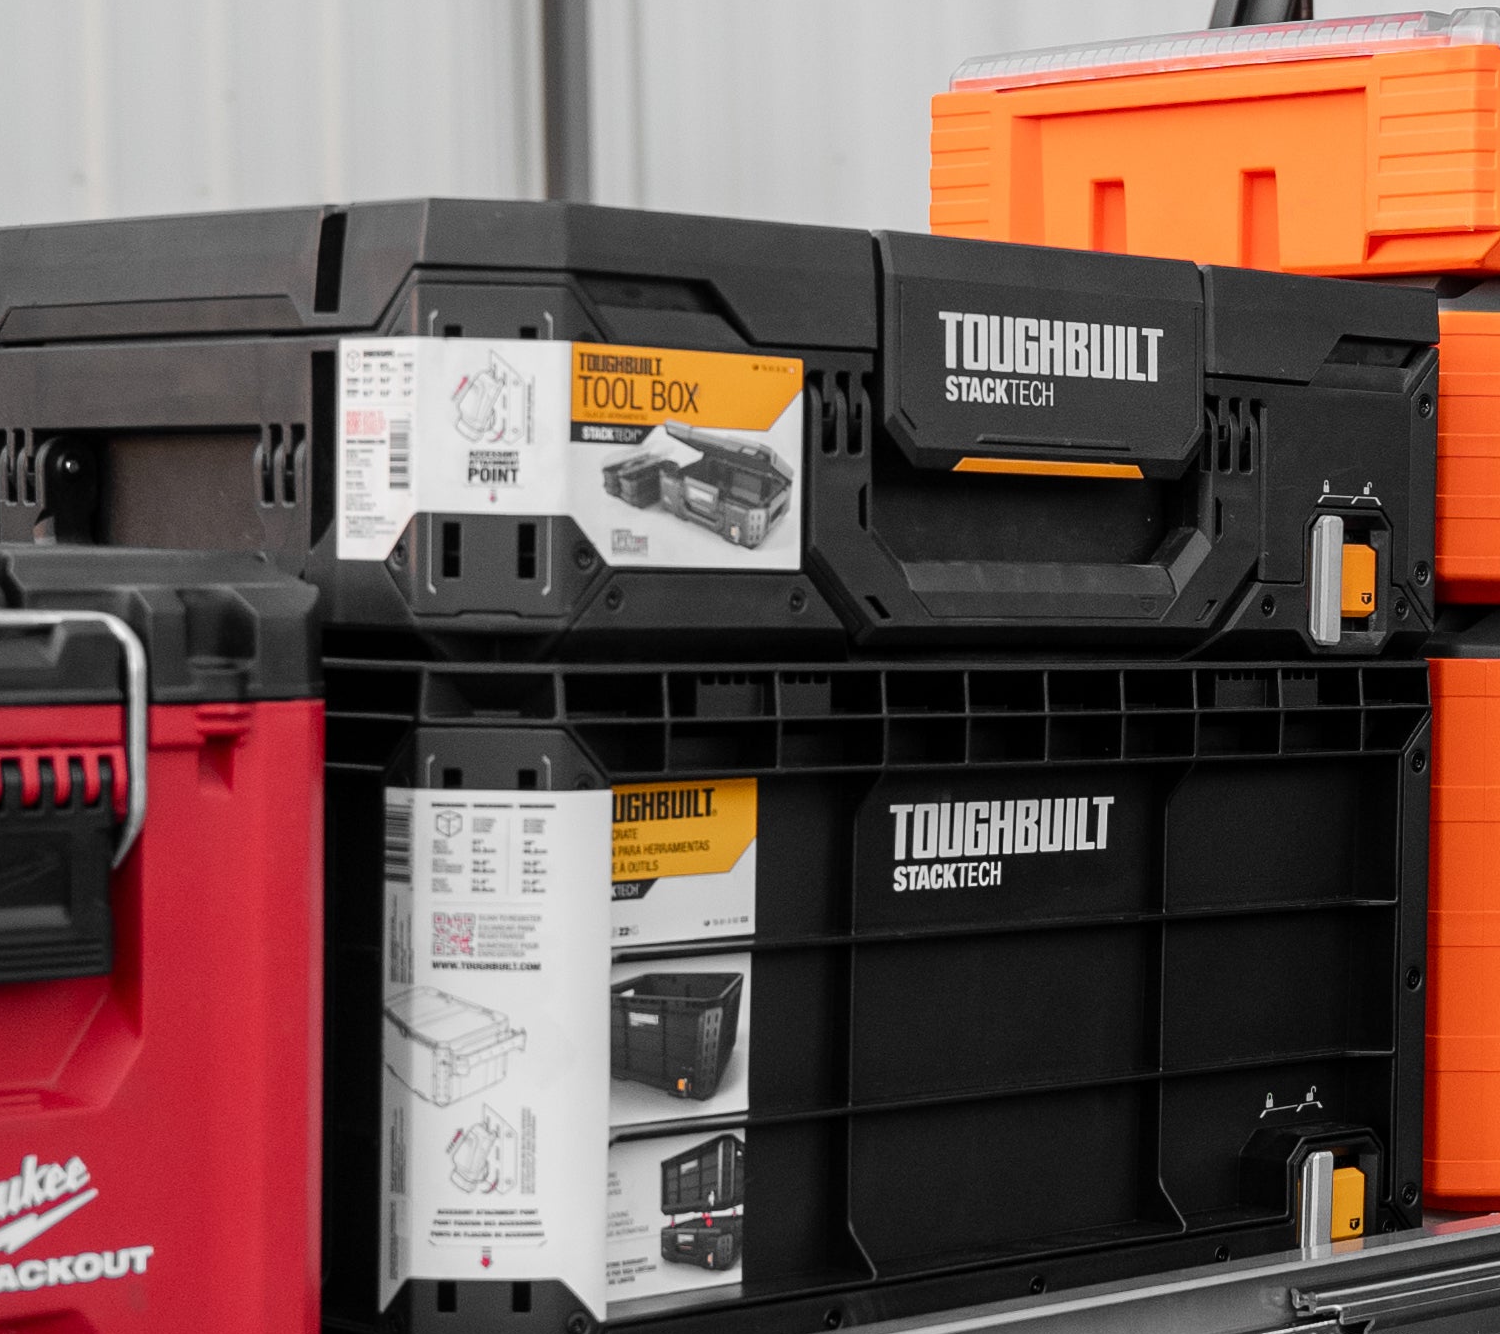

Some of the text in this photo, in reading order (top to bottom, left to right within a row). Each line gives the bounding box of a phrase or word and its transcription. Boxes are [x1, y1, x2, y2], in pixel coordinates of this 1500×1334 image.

[938, 311, 1164, 382] TOUGHBUILT
[579, 352, 662, 376] TOUGHBUILT
[578, 375, 699, 414] TOOL BOX
[945, 375, 1054, 407] STACKTECH
[468, 468, 519, 483] POINT
[612, 788, 715, 823] UGHBUILT
[890, 796, 1114, 860] TOUGHBUILT
[618, 840, 710, 856] PARA HERRAMIENTAS
[612, 884, 639, 897] KTECH
[893, 861, 1001, 891] STACKTECH
